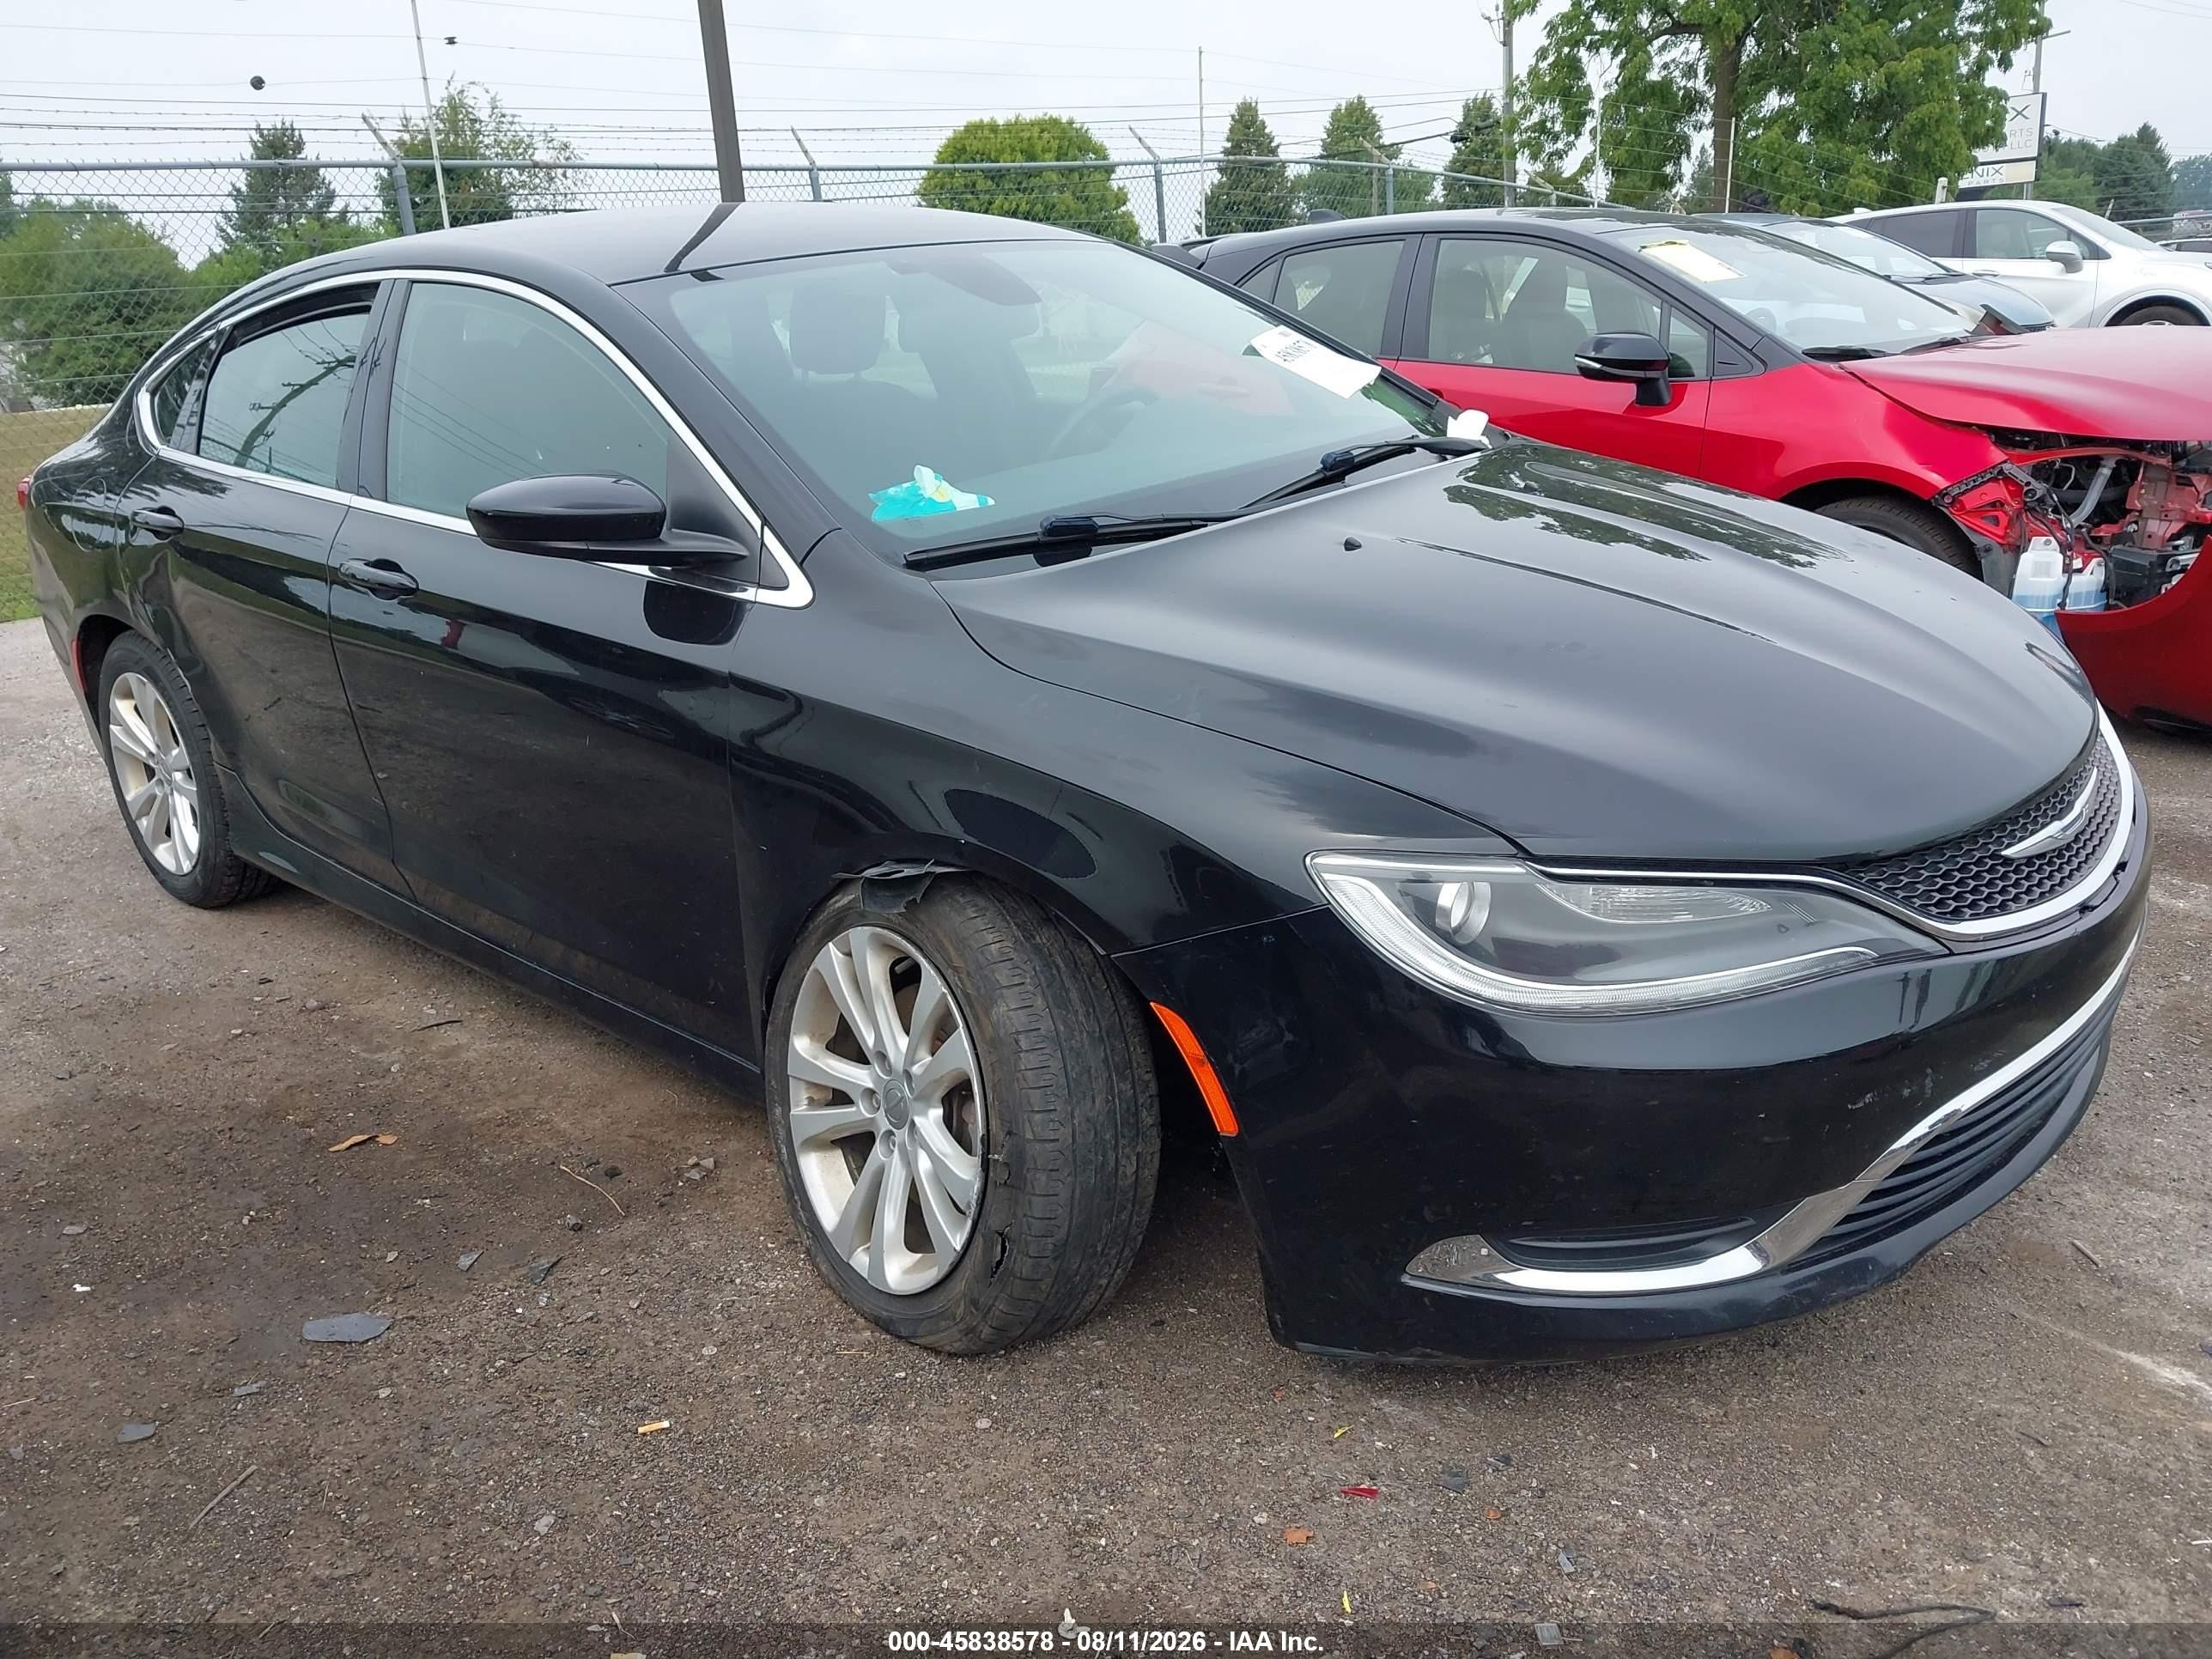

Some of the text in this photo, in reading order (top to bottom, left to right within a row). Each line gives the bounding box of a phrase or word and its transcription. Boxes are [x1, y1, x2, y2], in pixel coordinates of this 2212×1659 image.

[2009, 127, 2033, 138] RTS
[2010, 139, 2033, 149] LLC
[1963, 166, 2004, 179] NIX
[1967, 177, 2004, 186] PARTS
